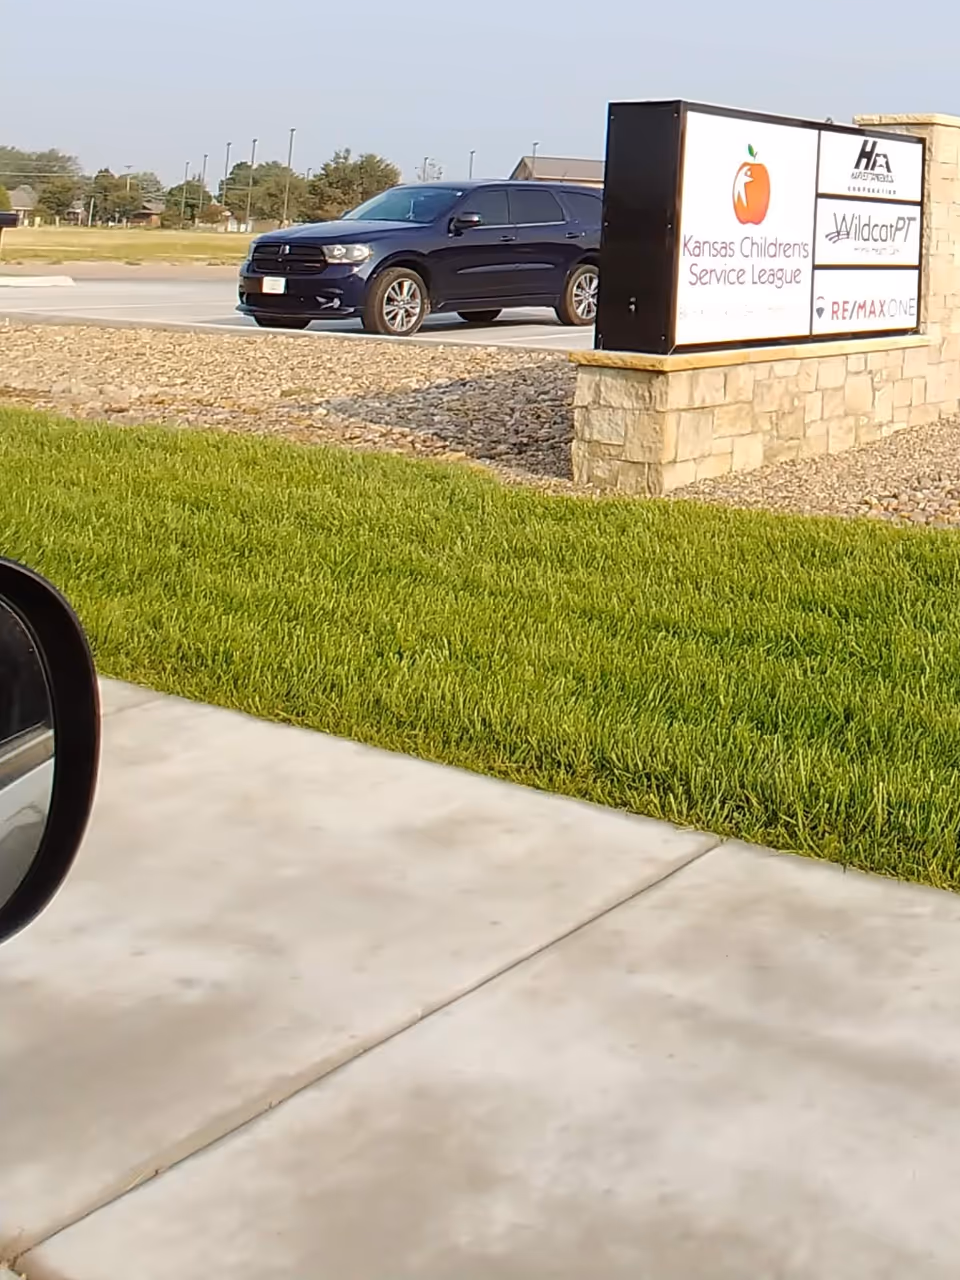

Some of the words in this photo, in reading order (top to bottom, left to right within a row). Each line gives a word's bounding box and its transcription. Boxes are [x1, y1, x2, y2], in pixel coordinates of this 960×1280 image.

[682, 235, 735, 259] Kansas
[739, 236, 810, 259] Children's
[688, 263, 746, 286] Service
[751, 264, 802, 289] League
